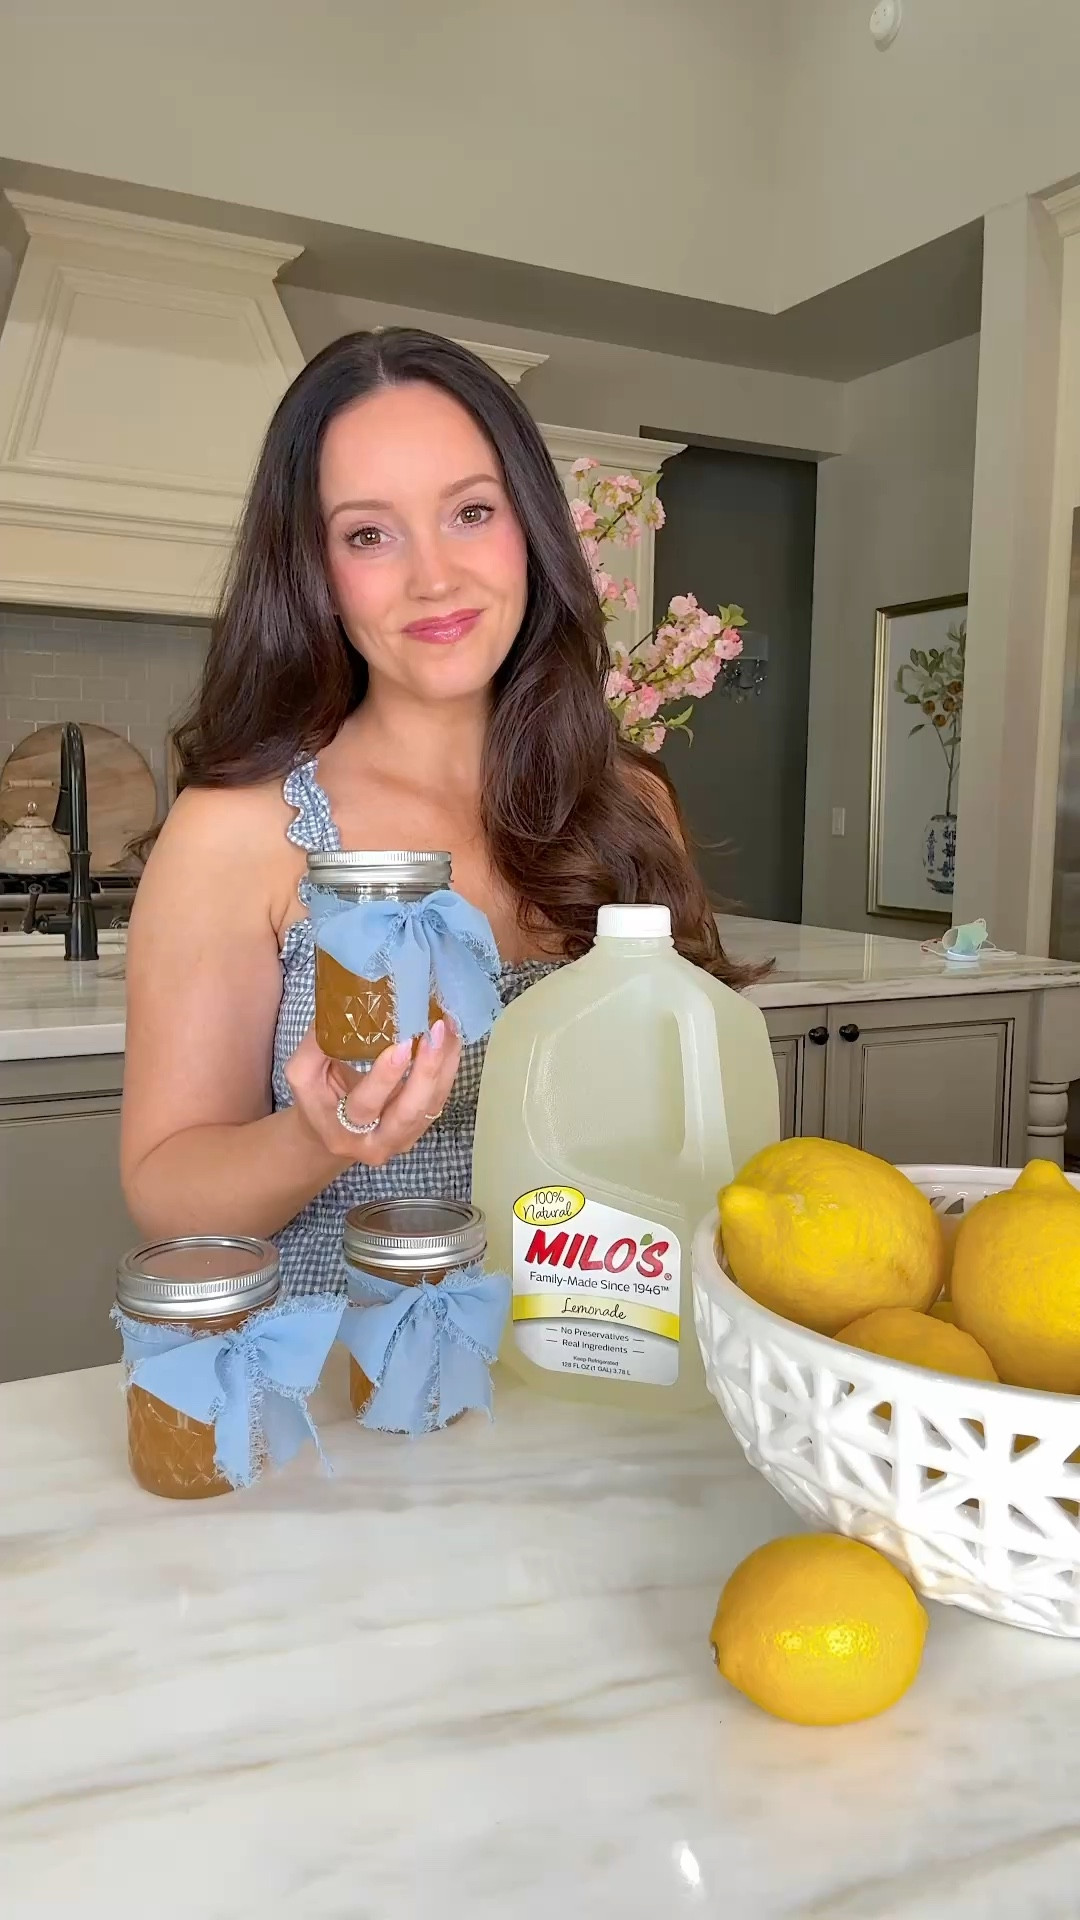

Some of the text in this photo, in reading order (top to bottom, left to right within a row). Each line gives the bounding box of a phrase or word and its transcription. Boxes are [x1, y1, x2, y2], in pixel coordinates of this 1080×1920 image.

[534, 1190, 564, 1204] 100%
[523, 1201, 572, 1221] Natural
[530, 1271, 598, 1288] Family-Made
[600, 1280, 630, 1292] Since
[562, 1298, 627, 1320] Lemonade
[561, 1327, 629, 1342] No Preservatives
[562, 1339, 628, 1353] Real Ingredients
[613, 1367, 625, 1375] 3.78
